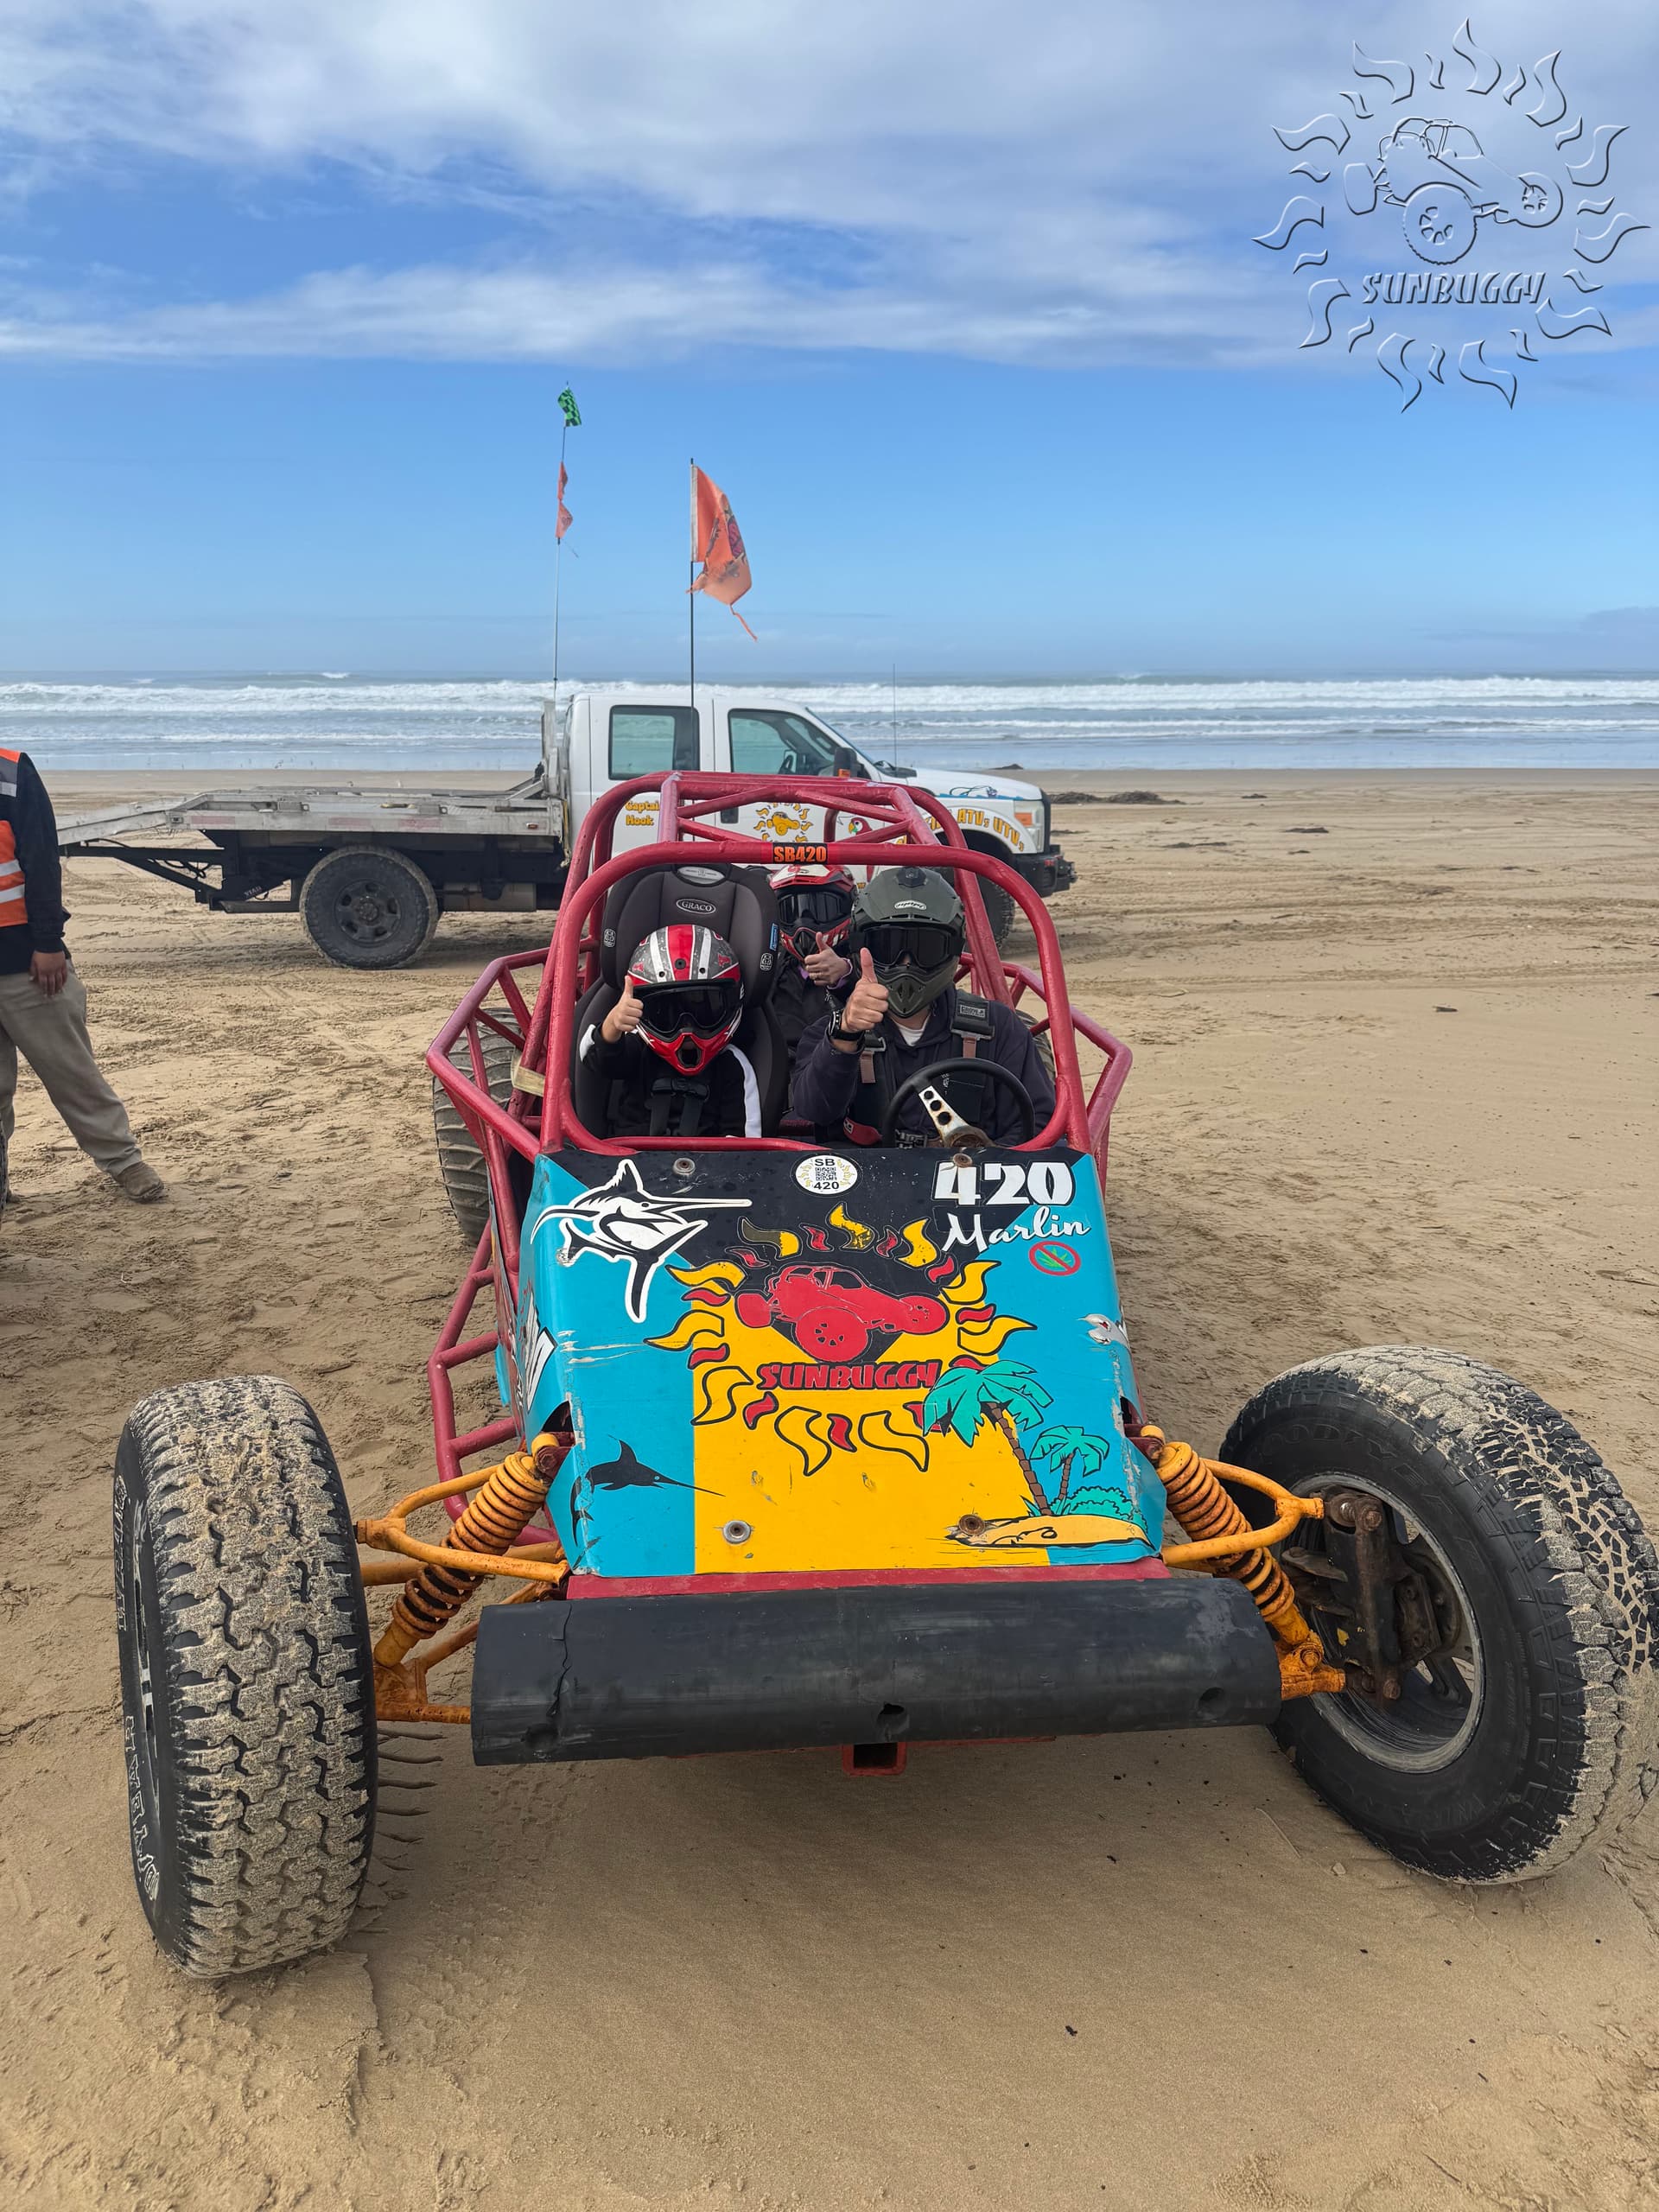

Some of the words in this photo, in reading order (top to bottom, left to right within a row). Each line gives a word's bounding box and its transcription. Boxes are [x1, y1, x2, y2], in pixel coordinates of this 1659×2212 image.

[625, 800, 660, 813] Captai
[626, 815, 654, 825] Hook
[957, 808, 990, 829] ATVs
[993, 816, 1025, 852] UTVs
[773, 846, 827, 862] SB420
[681, 900, 712, 912] GRACO
[934, 1162, 1074, 1205] 420
[942, 1205, 1090, 1253] Marlin
[757, 1361, 942, 1389] SUNBUGGY
